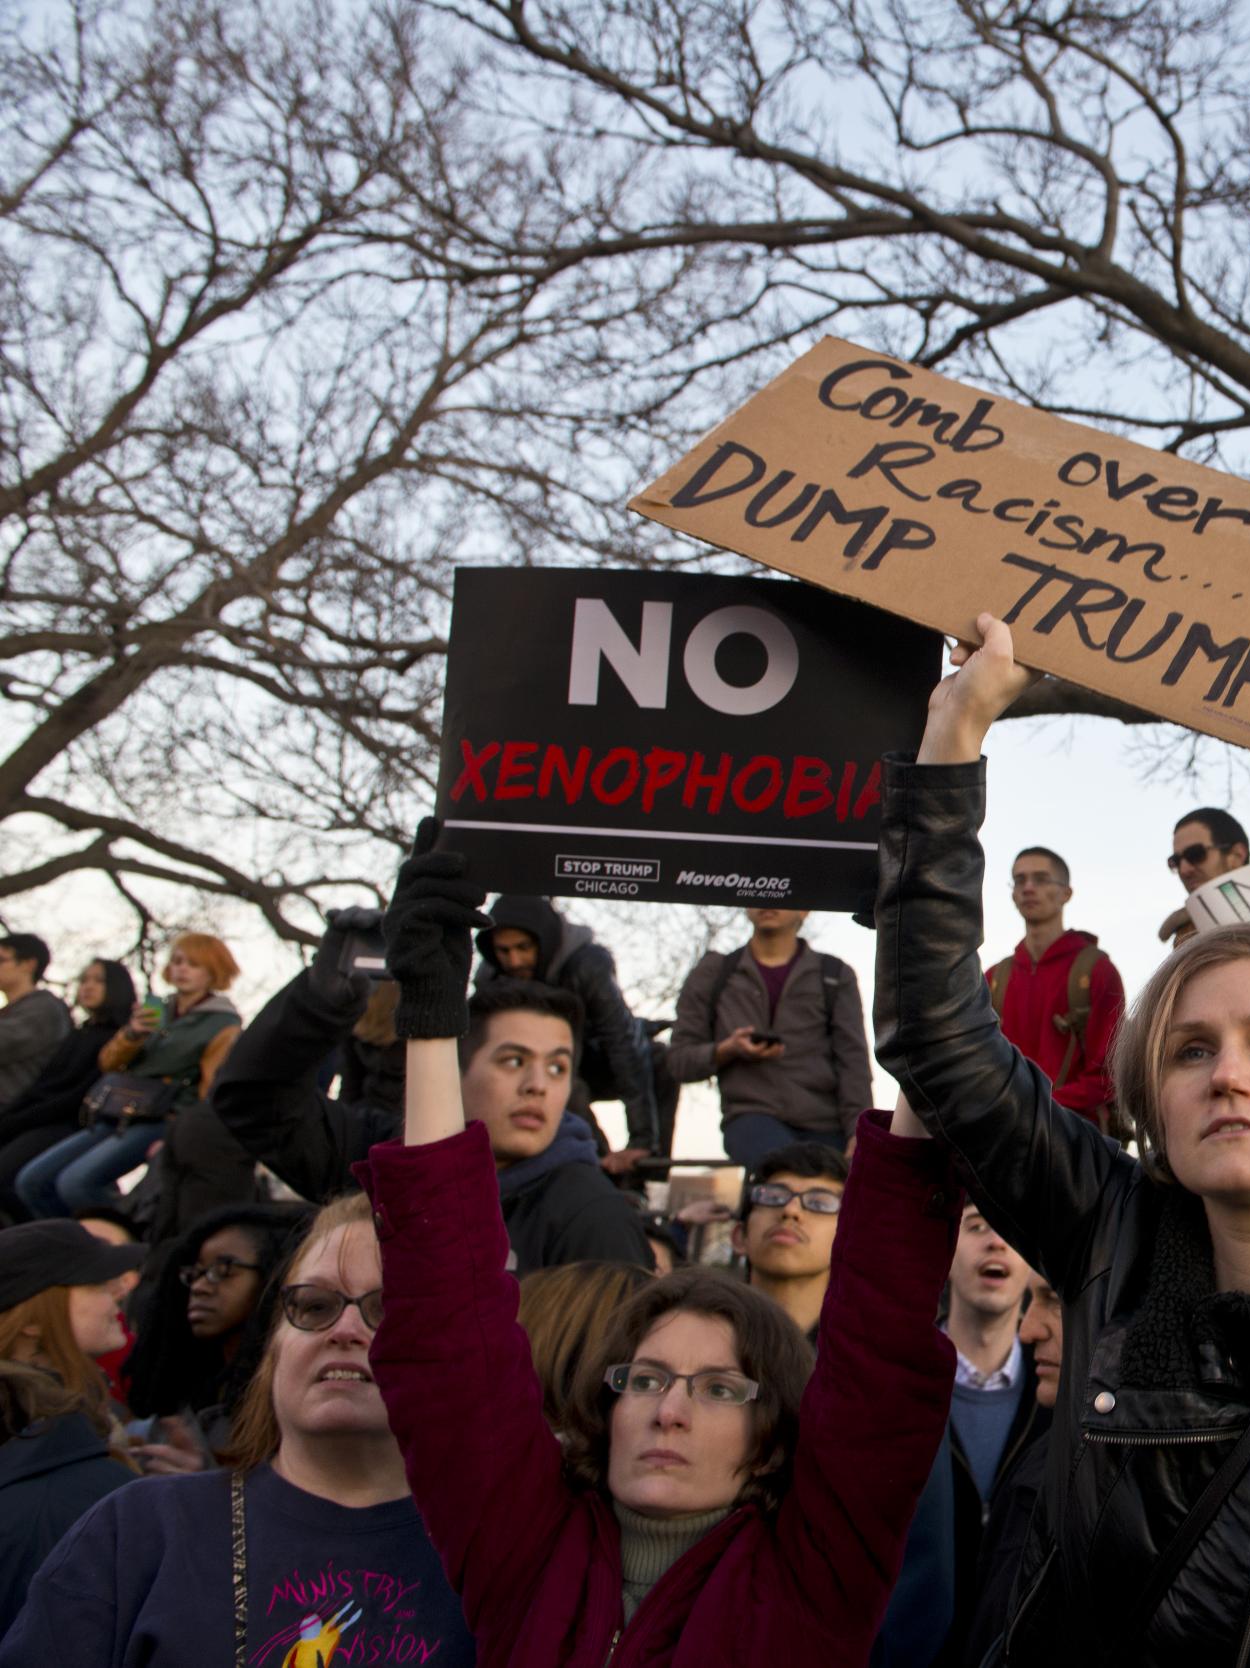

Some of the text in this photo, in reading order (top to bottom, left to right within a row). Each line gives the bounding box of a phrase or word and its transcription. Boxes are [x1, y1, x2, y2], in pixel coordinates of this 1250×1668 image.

[818, 359, 1005, 454] Comb
[668, 441, 936, 571] DUMP
[568, 597, 799, 716] NO
[563, 860, 653, 877] STOP TRUMP
[575, 880, 639, 895] CHICAGO
[675, 870, 790, 890] MoveOn.ORG
[736, 889, 757, 898] CIVIC
